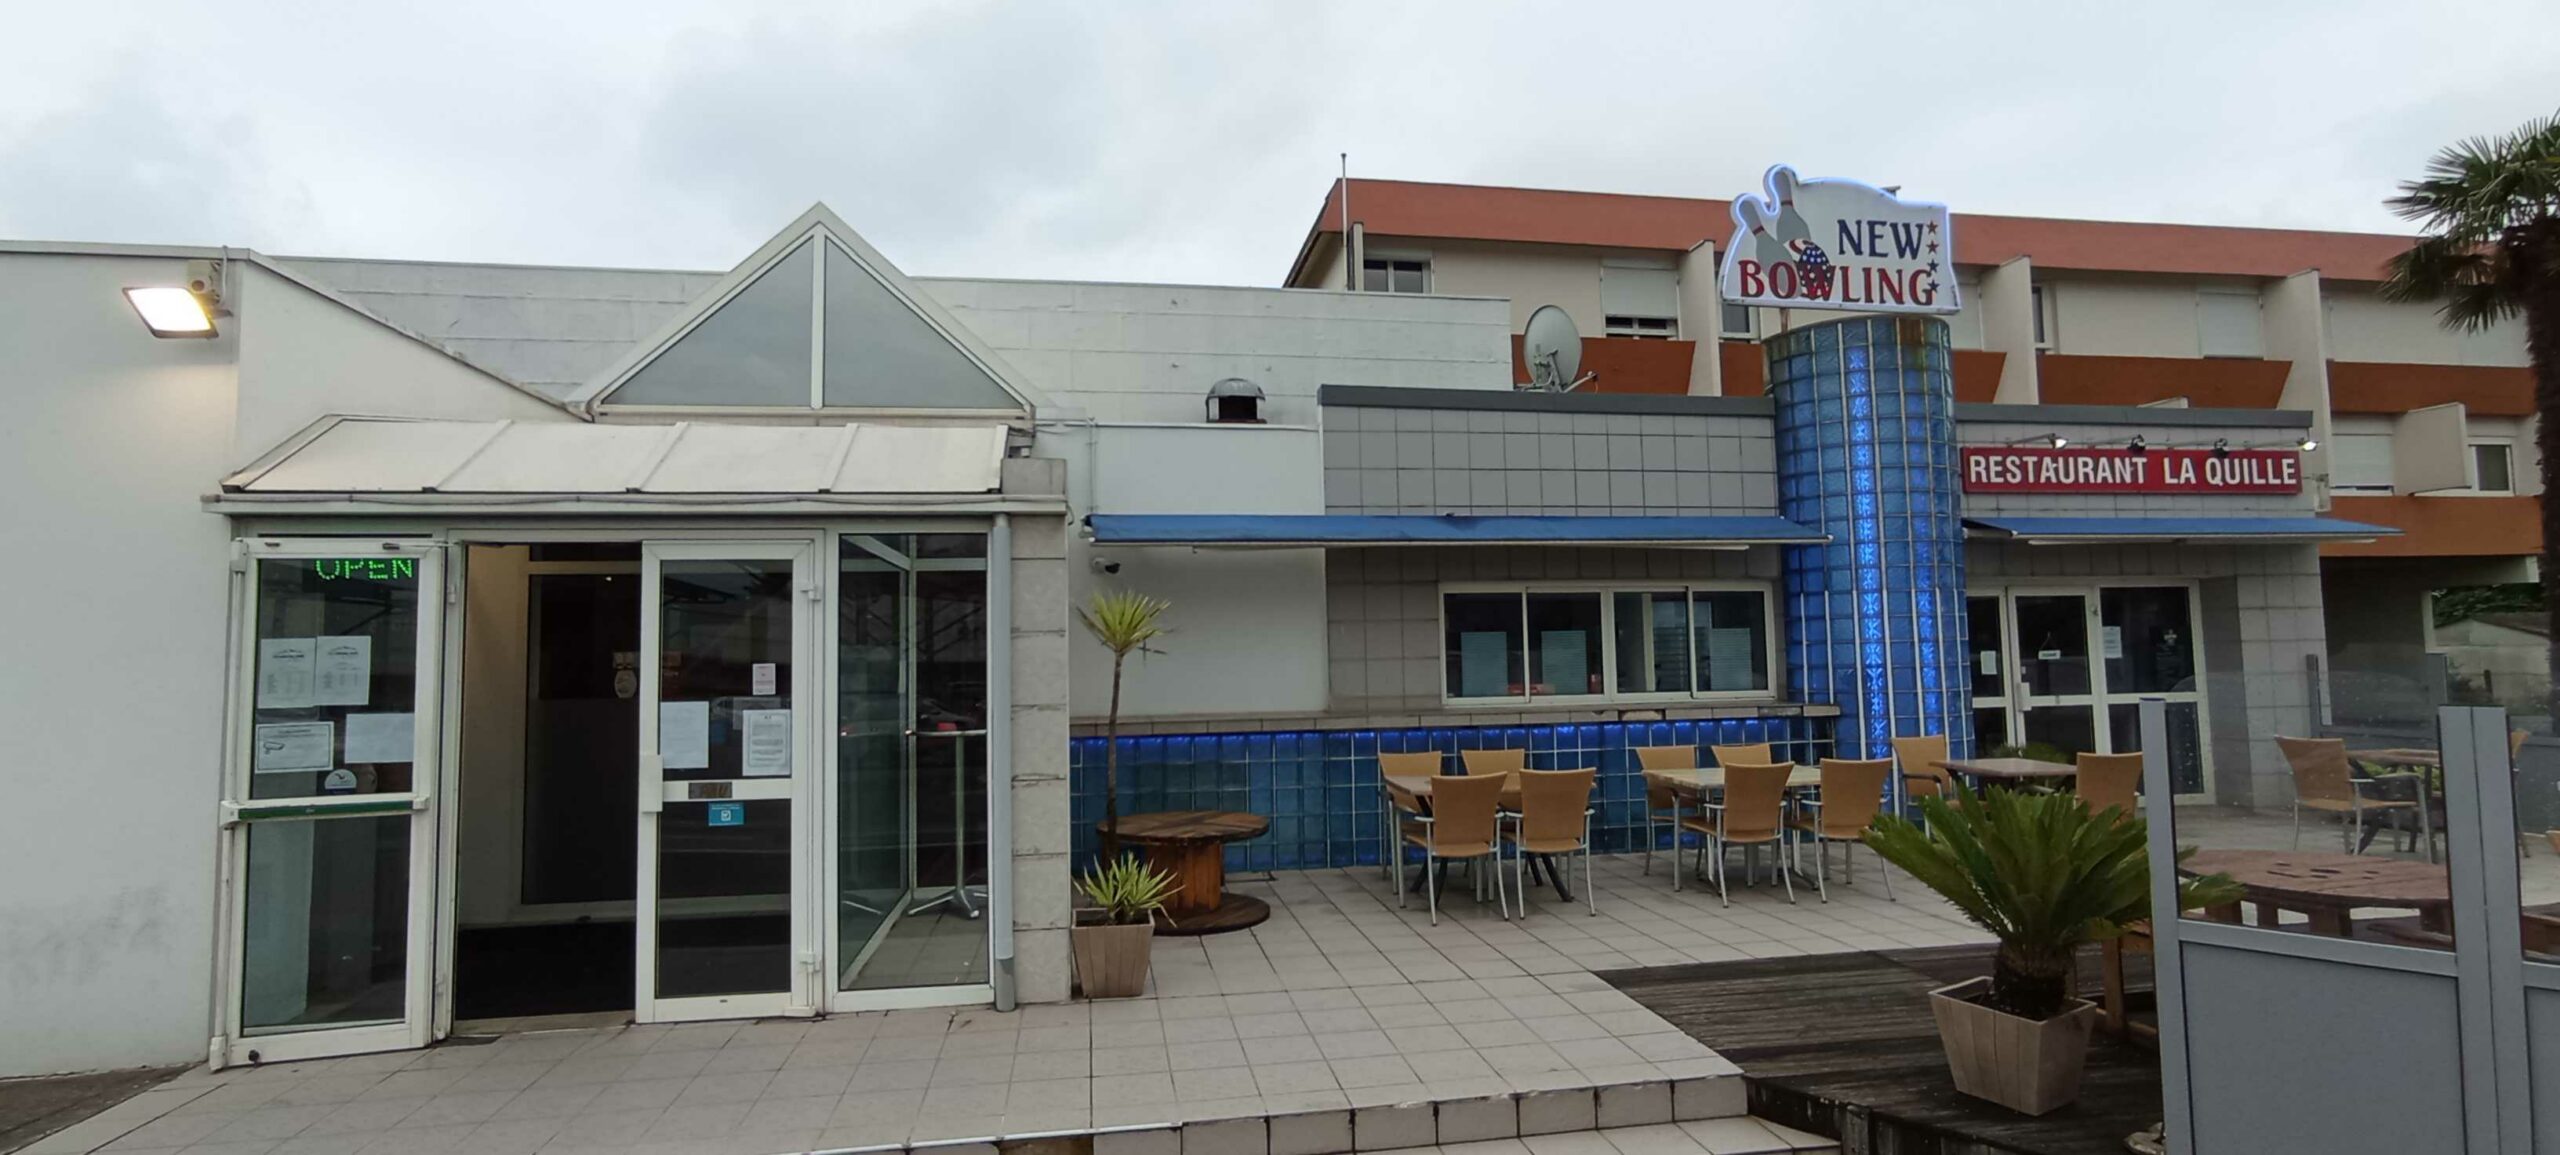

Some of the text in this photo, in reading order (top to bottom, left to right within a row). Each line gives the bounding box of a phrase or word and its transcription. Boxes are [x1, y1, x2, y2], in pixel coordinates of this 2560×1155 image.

[1836, 219, 1925, 260] NEW
[1737, 259, 1936, 306] BOWLING
[1968, 455, 2297, 487] RESTAURANT LA QUILLE
[315, 559, 413, 580] OPEN
